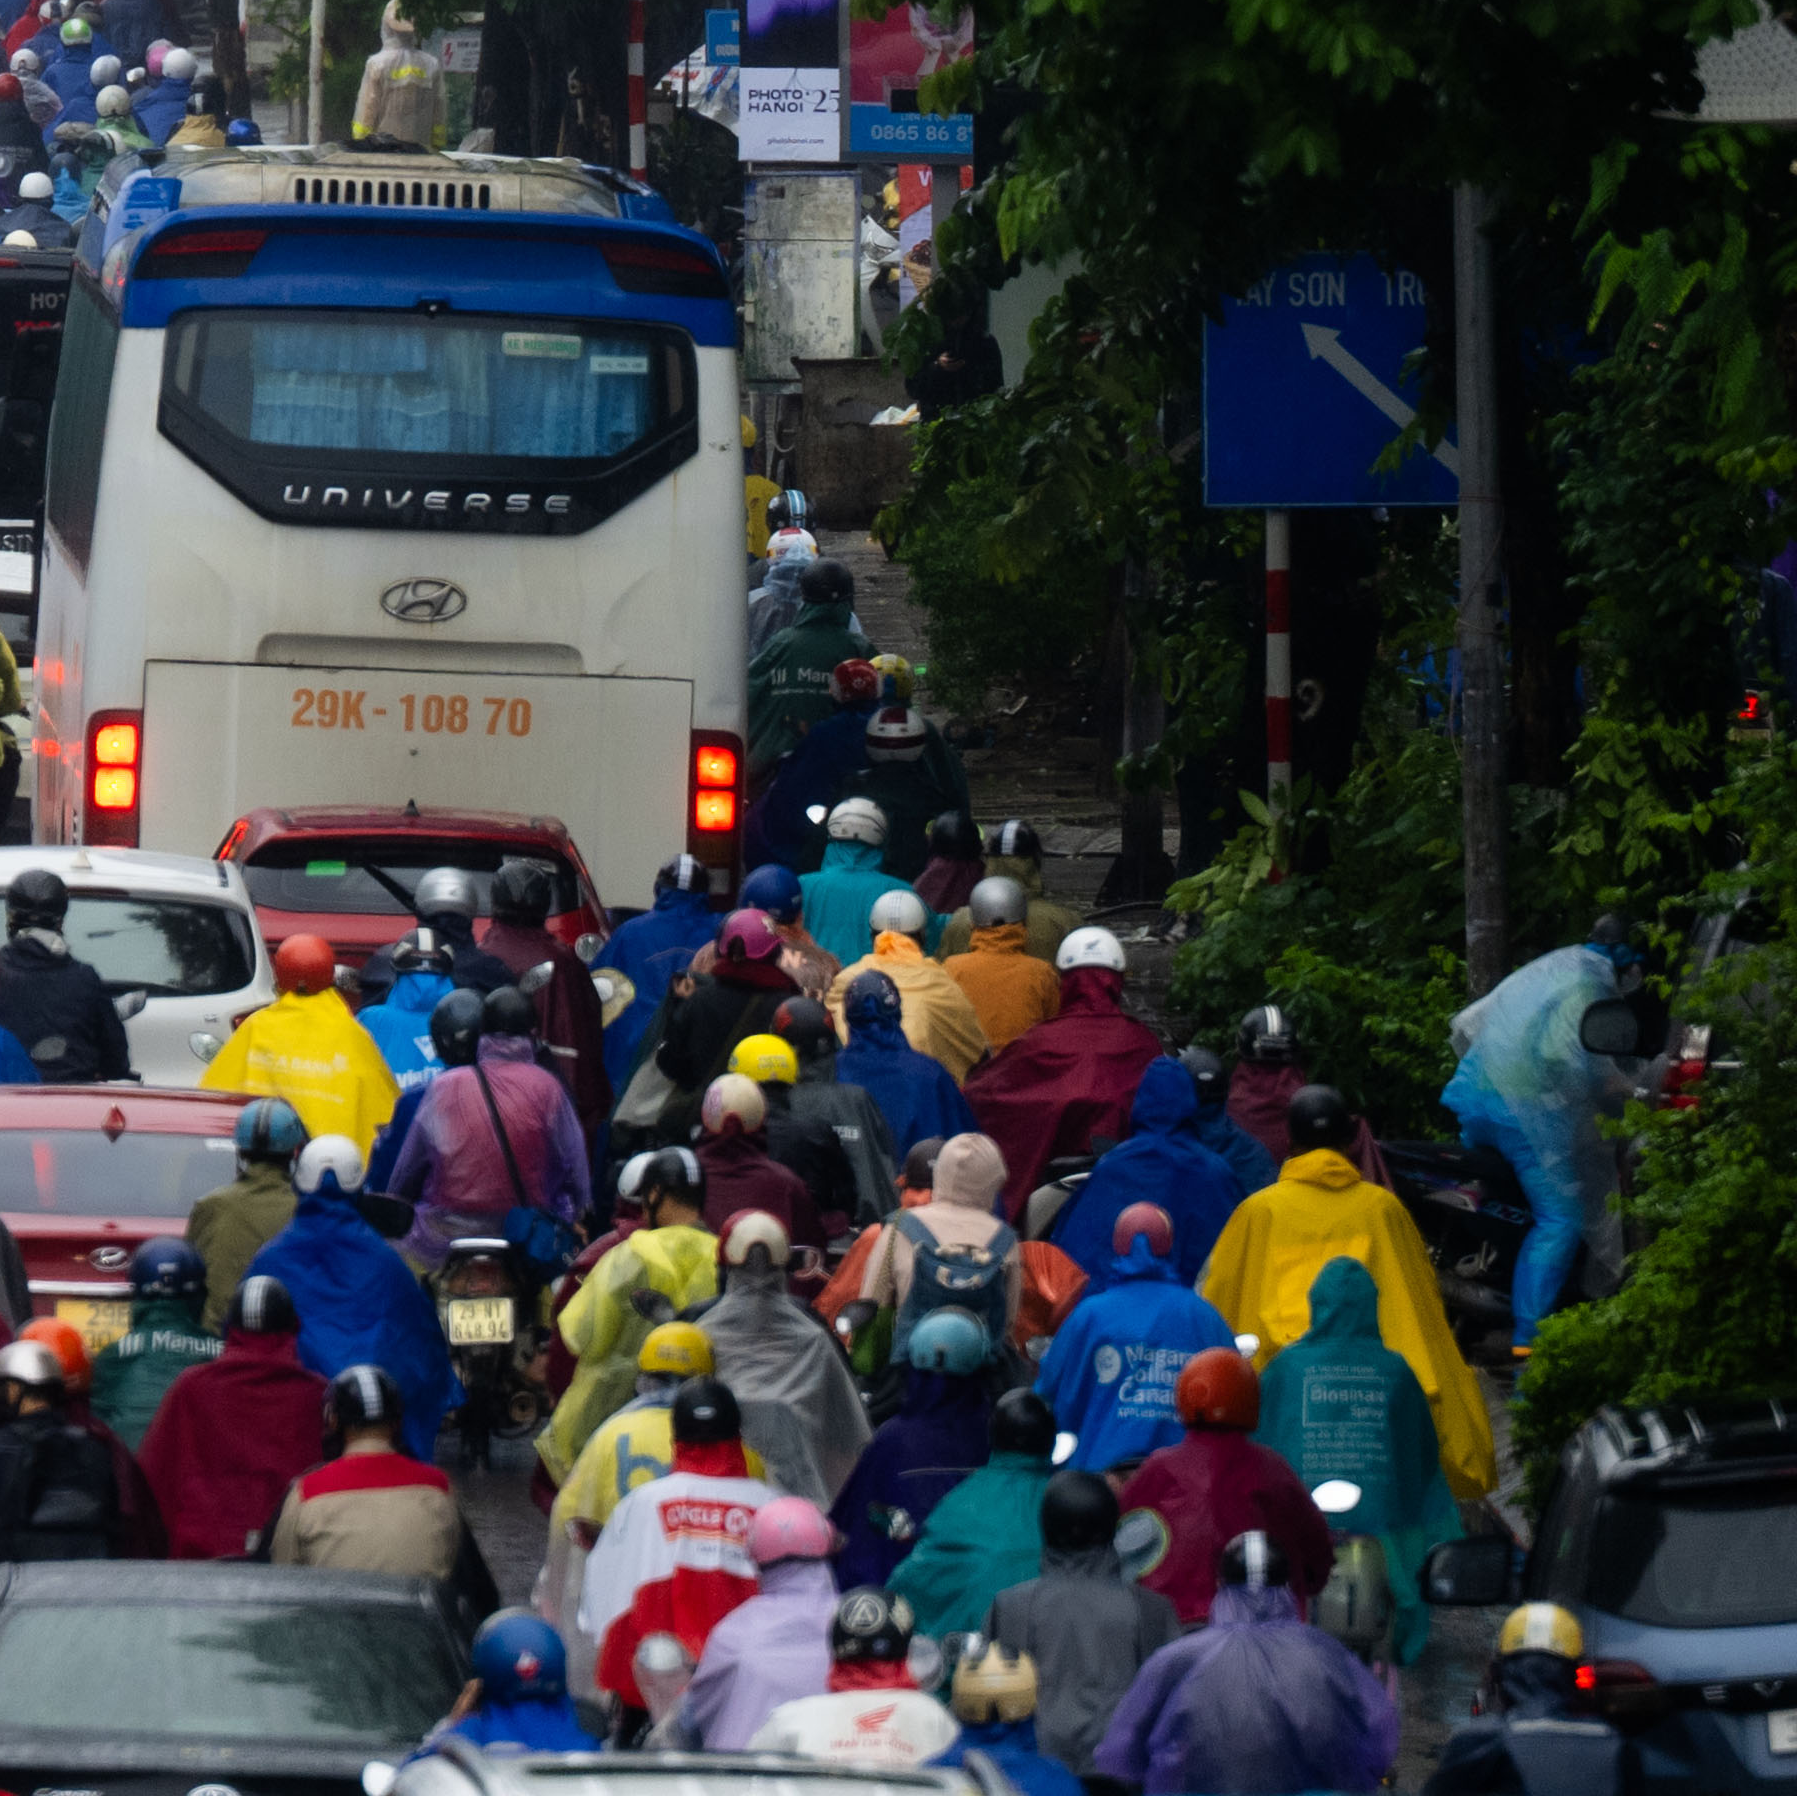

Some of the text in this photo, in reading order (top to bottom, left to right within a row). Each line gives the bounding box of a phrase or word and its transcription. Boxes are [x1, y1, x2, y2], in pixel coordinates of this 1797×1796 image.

[748, 89, 803, 101] PHOTO
[748, 102, 803, 113] HANOI
[871, 124, 972, 143] 0865 86 8
[31, 293, 68, 310] HO
[283, 484, 573, 514] UNIVERSE
[291, 687, 368, 732] 29K
[399, 692, 470, 735] 108
[482, 696, 533, 738] 70
